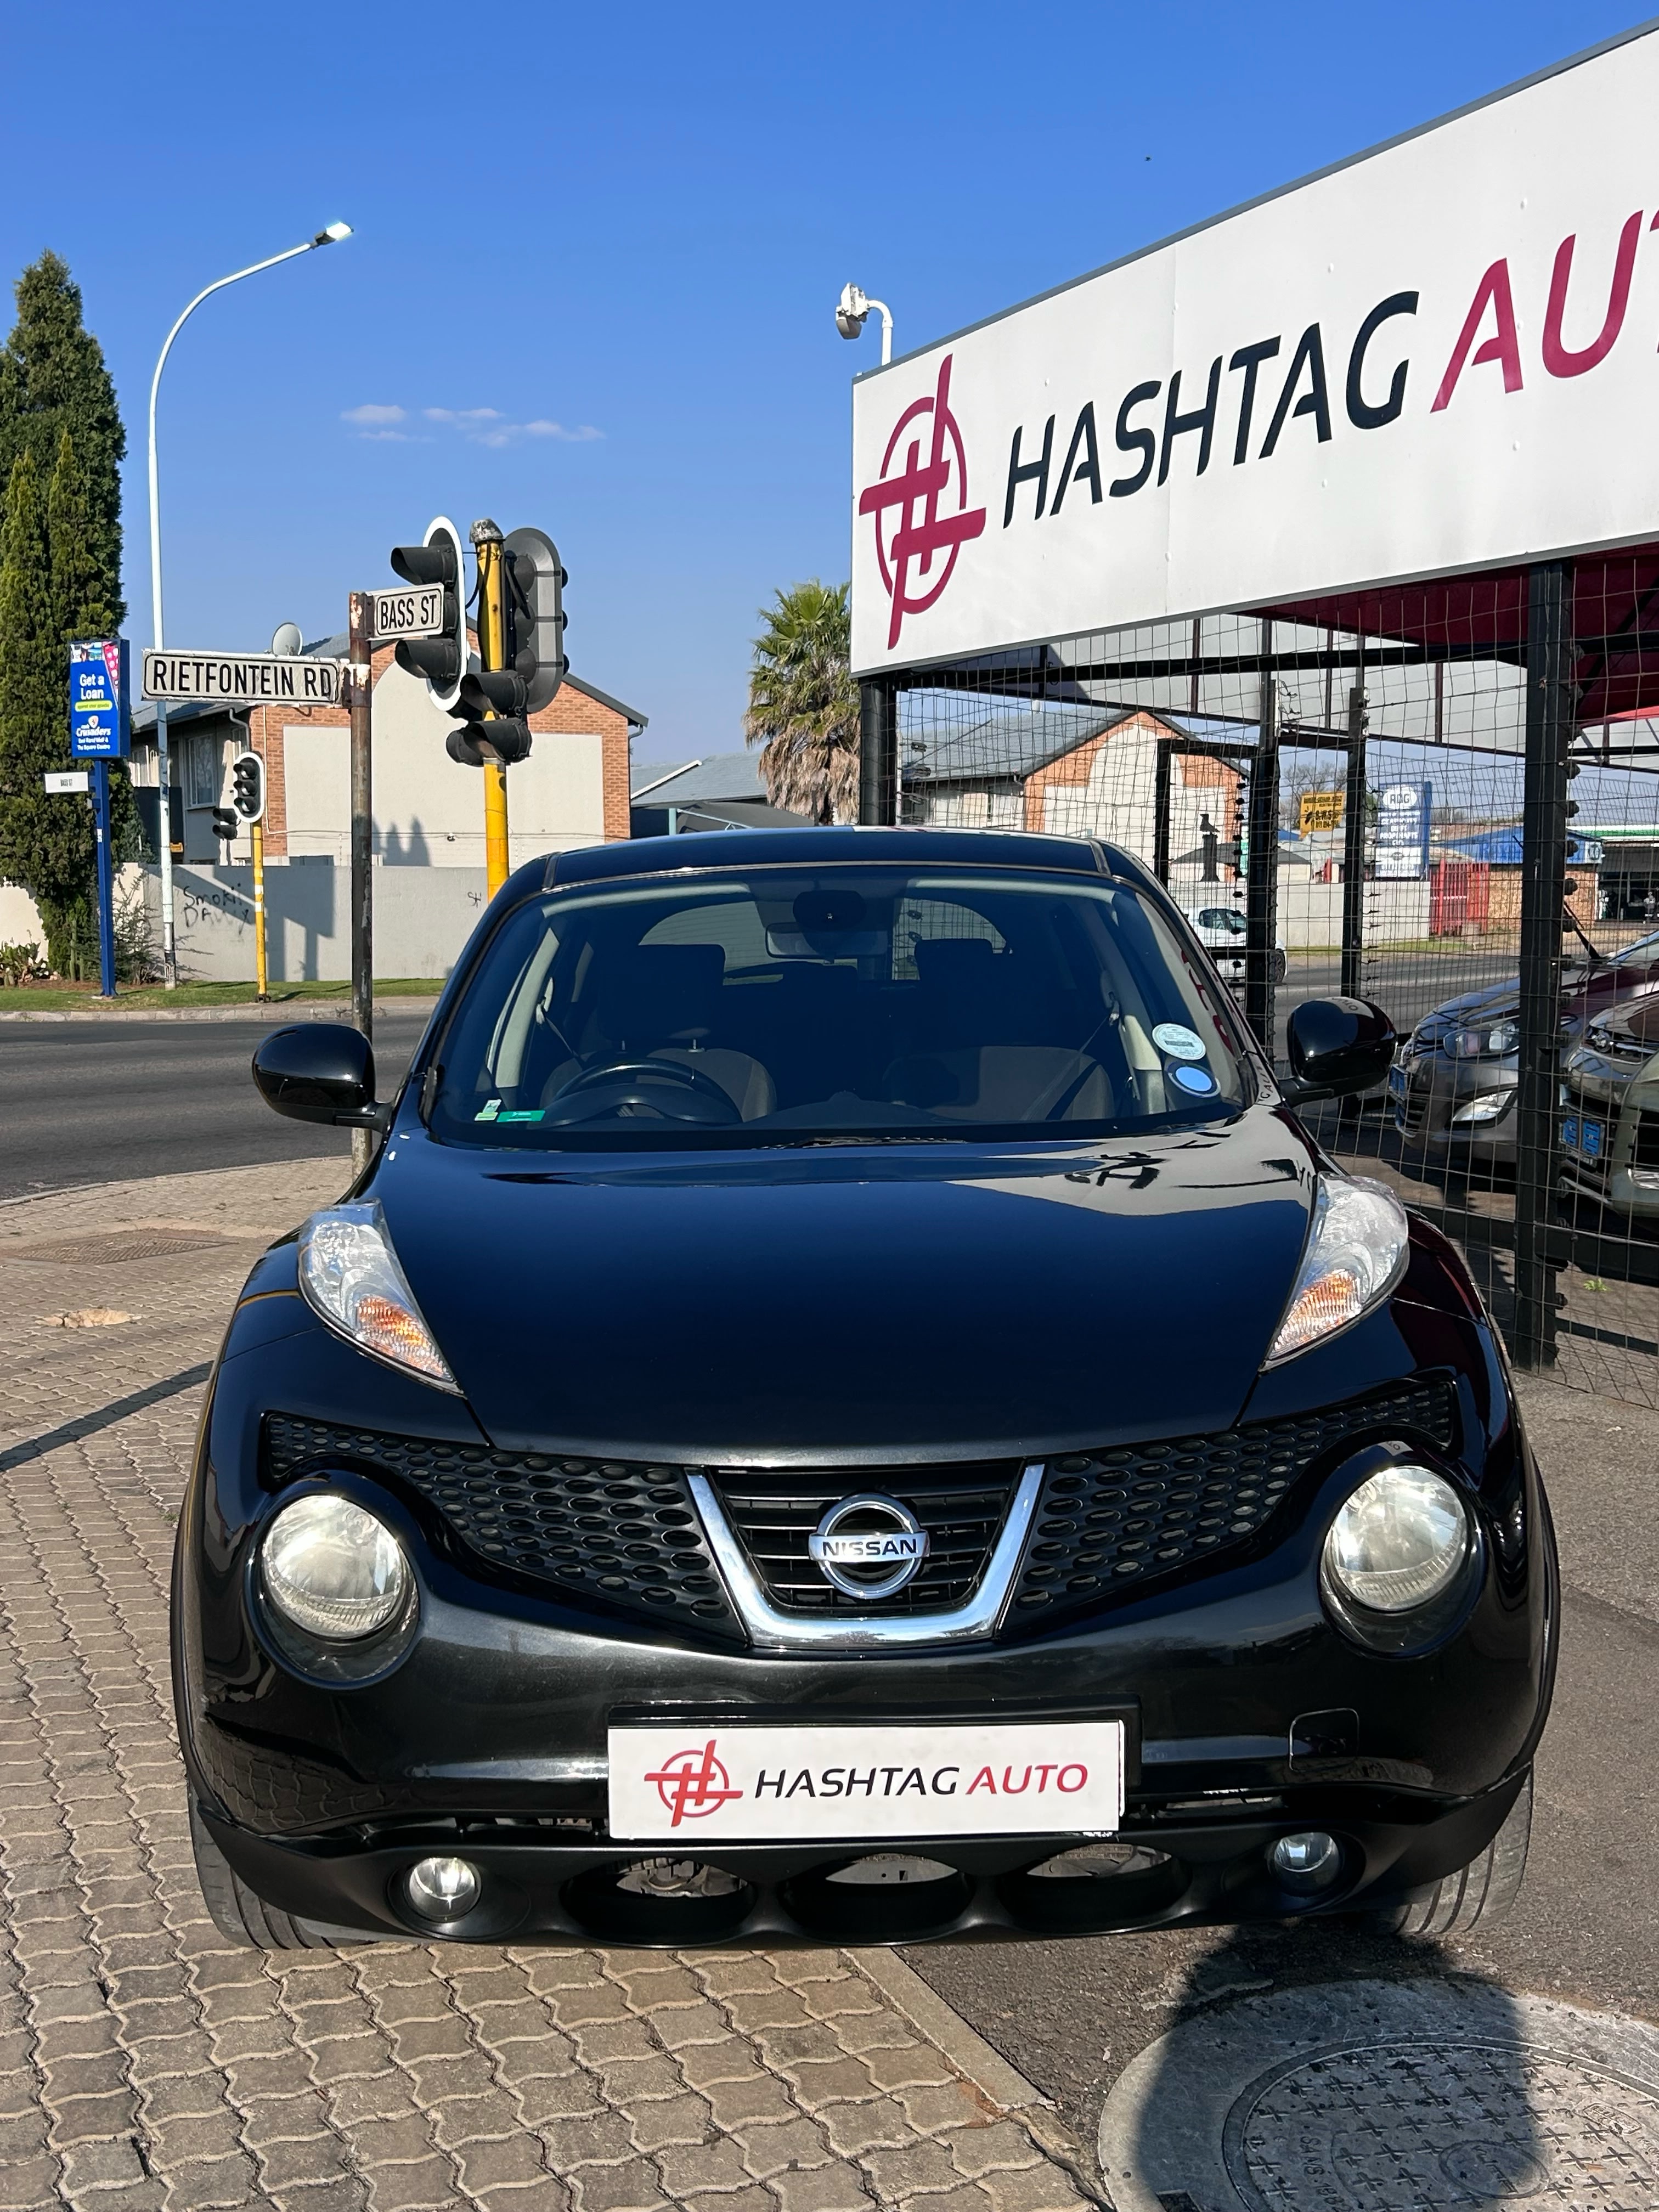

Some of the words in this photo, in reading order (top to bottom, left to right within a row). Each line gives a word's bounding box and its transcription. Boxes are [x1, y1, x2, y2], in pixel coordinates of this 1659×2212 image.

[1003, 291, 1419, 528] HASHTAG
[1430, 210, 1659, 413] AU
[381, 597, 414, 630] BASS
[421, 594, 437, 625] ST
[80, 674, 96, 686] Get
[98, 675, 105, 686] a
[81, 687, 104, 700] Loan
[153, 659, 295, 695] RIETFONTEIN
[304, 667, 331, 697] RD
[822, 1538, 917, 1556] NISSAN
[754, 1767, 960, 1798] HASHTAG
[966, 1764, 1088, 1795] AUTO
